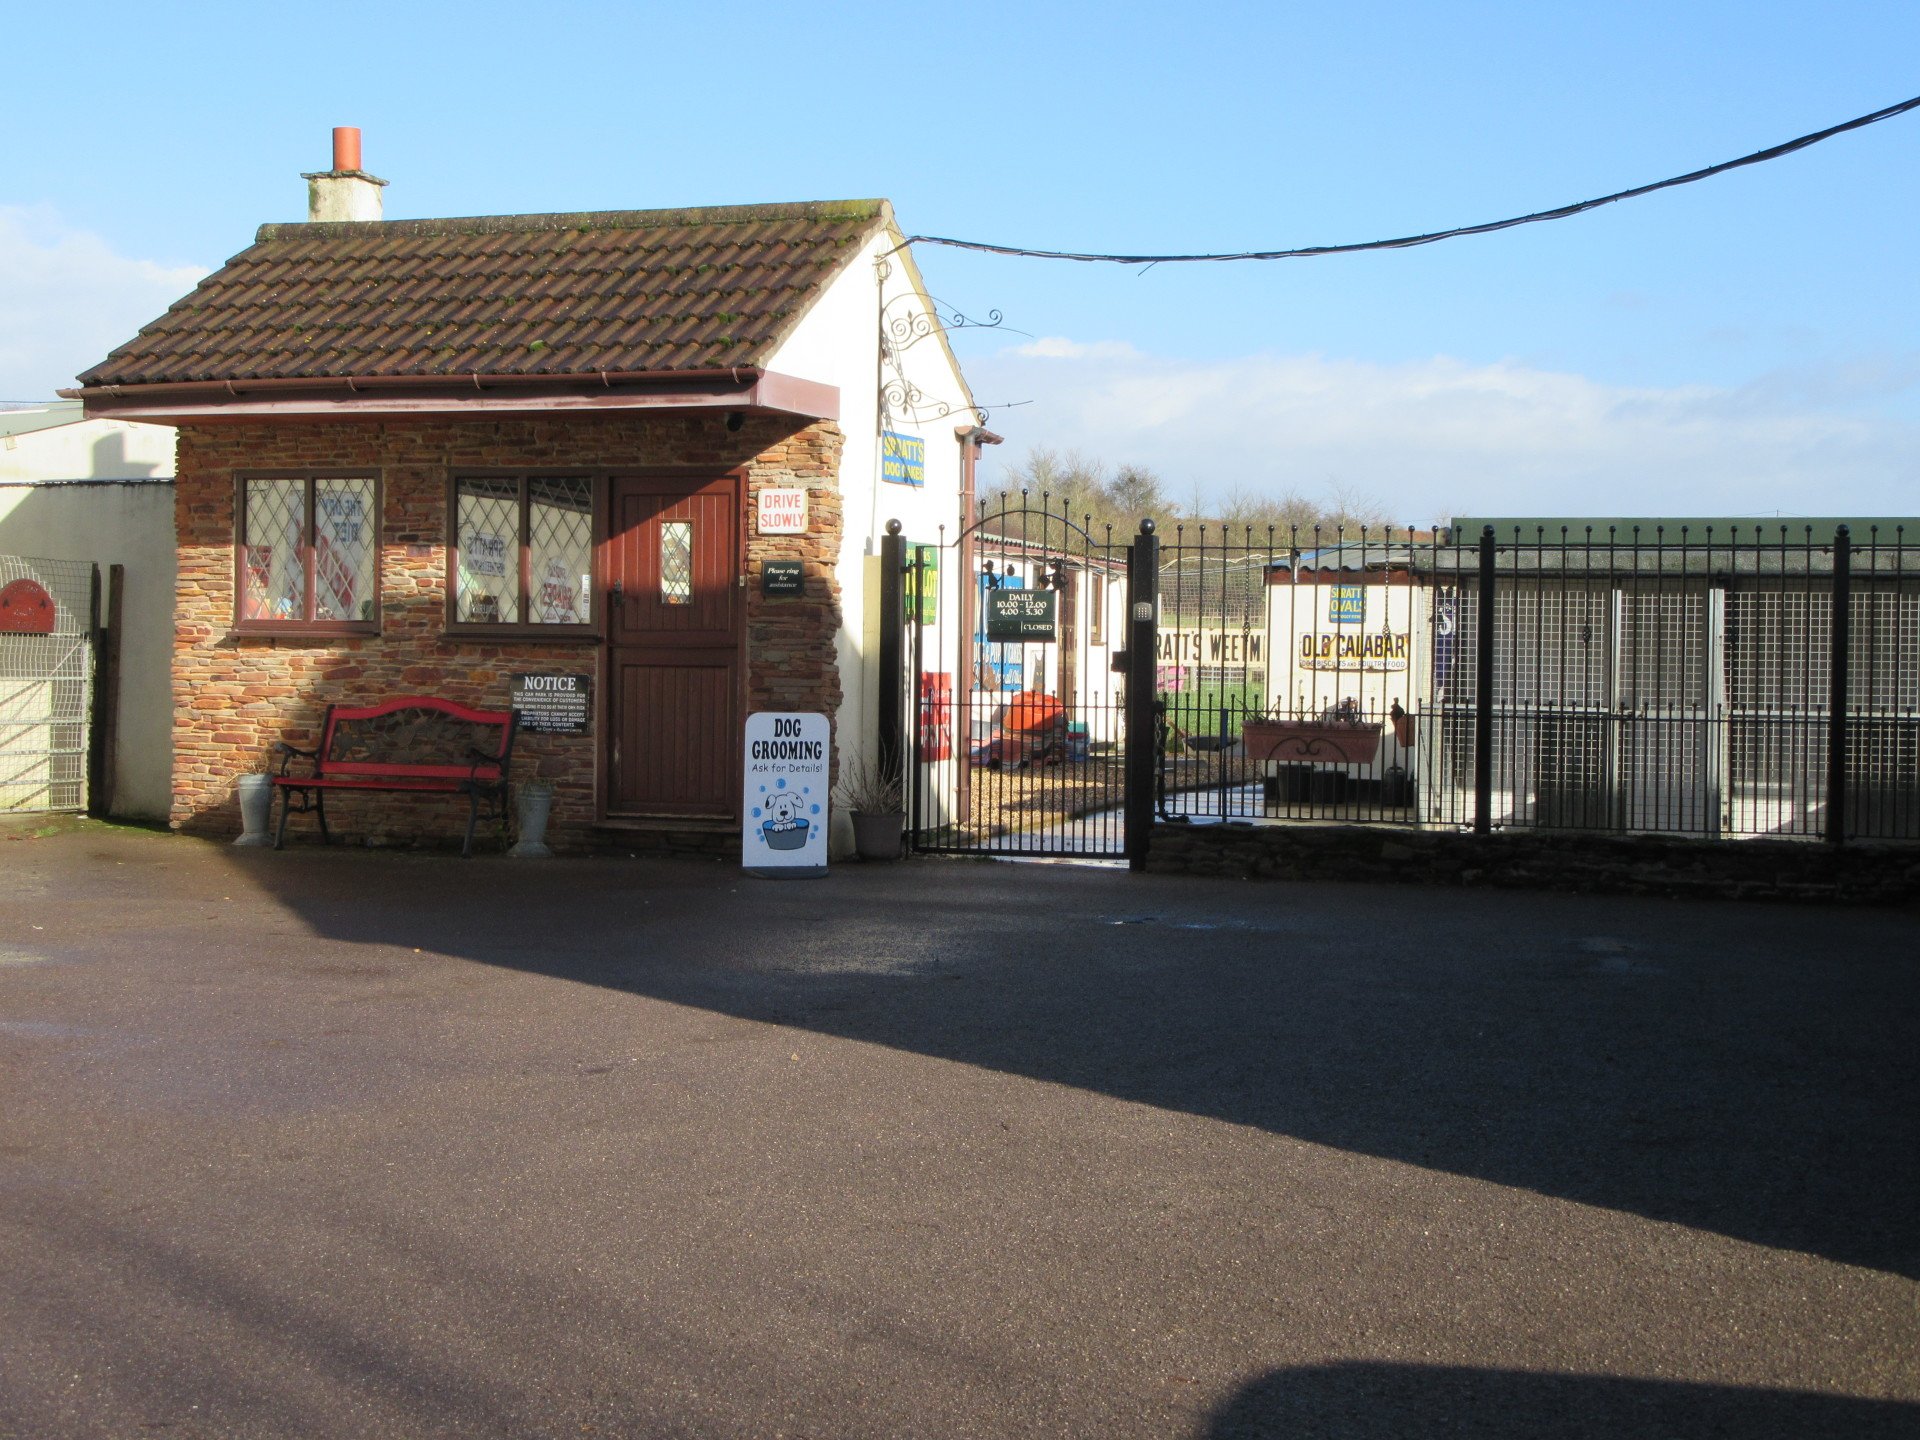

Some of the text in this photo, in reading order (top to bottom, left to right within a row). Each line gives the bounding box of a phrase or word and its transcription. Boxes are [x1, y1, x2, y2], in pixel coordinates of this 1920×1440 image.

[884, 461, 900, 477] DOG
[764, 494, 801, 509] DRIVE
[761, 513, 805, 527] SLOWLY
[1331, 587, 1367, 599] SRATT
[1000, 608, 1019, 616] 4.00
[1025, 608, 1044, 616] 5.30
[1025, 601, 1047, 609] 12.00
[1330, 600, 1366, 612] OVALS
[1210, 634, 1266, 662] WEETM
[1302, 634, 1406, 658] OD CALABAR
[1388, 660, 1406, 668] FOOD
[524, 676, 576, 691] NOTICE
[774, 718, 802, 738] DOG
[752, 740, 823, 760] GROOMING
[752, 763, 823, 773] Ask for Details!
